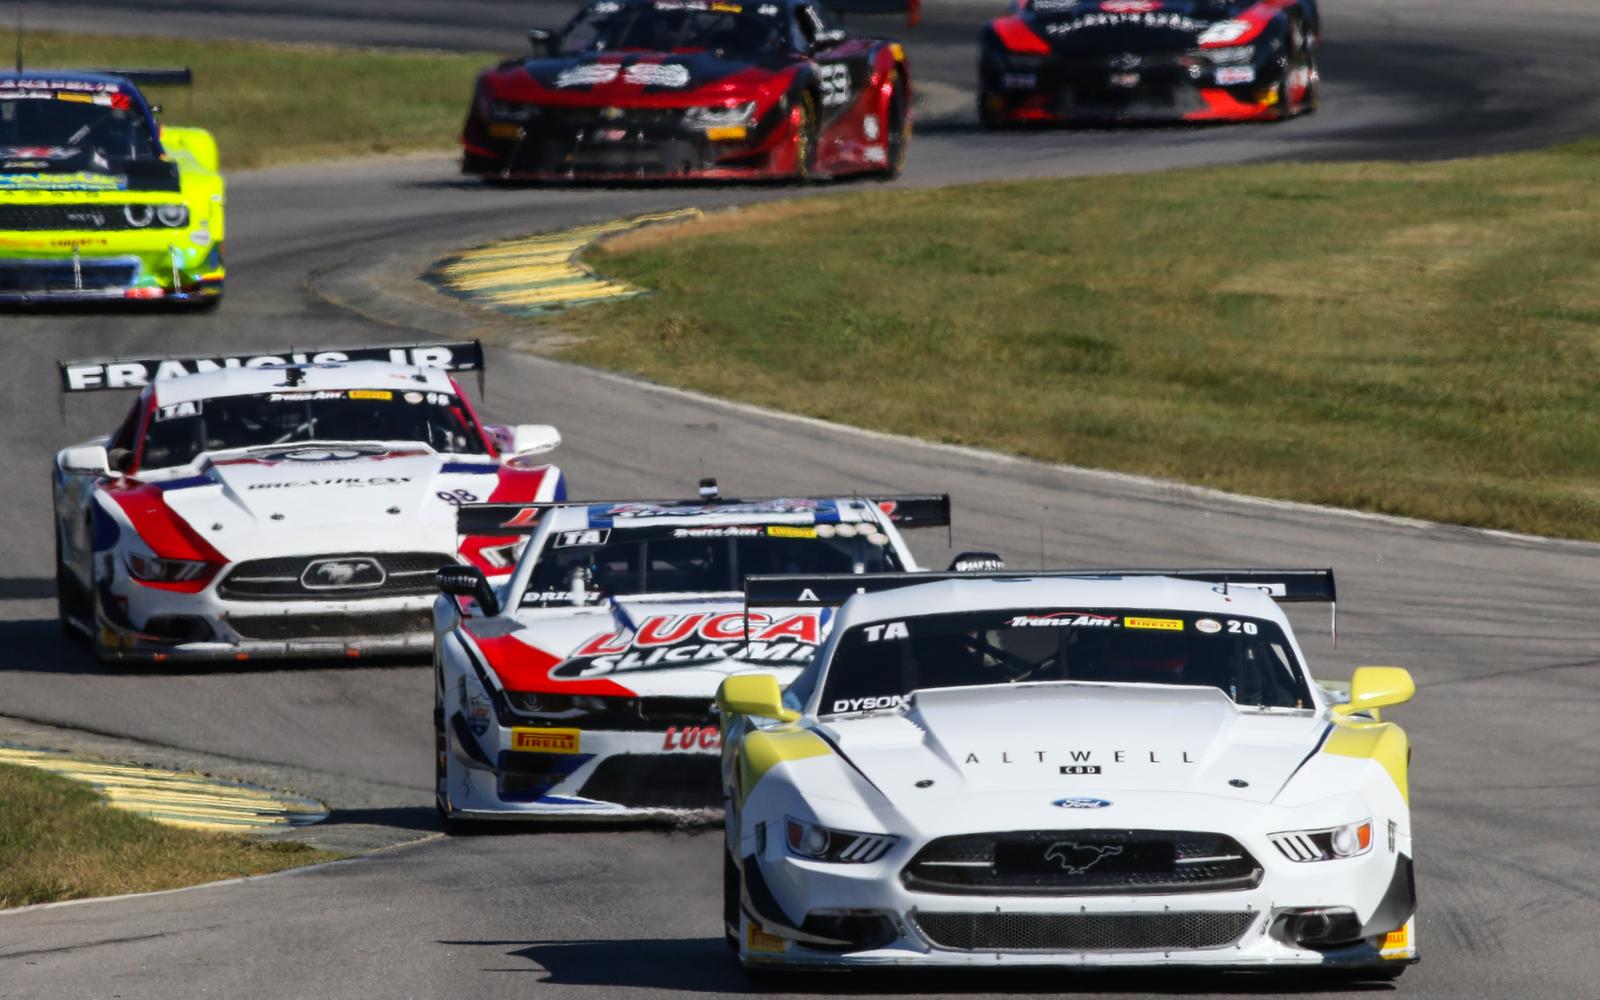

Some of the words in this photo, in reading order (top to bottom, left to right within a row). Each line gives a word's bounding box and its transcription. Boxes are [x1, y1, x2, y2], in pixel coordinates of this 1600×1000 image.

[162, 401, 196, 418] TA
[436, 488, 478, 505] 98
[564, 530, 601, 545] TA
[1011, 615, 1071, 627] Trans
[1227, 620, 1258, 635] 20
[863, 621, 909, 642] TA
[833, 694, 911, 713] DYSON
[517, 731, 576, 749] PIRELLI
[662, 726, 721, 751] LUC
[965, 750, 1194, 764] ALTWELL
[1065, 766, 1096, 775] CBD
[1062, 799, 1101, 809] Ford
